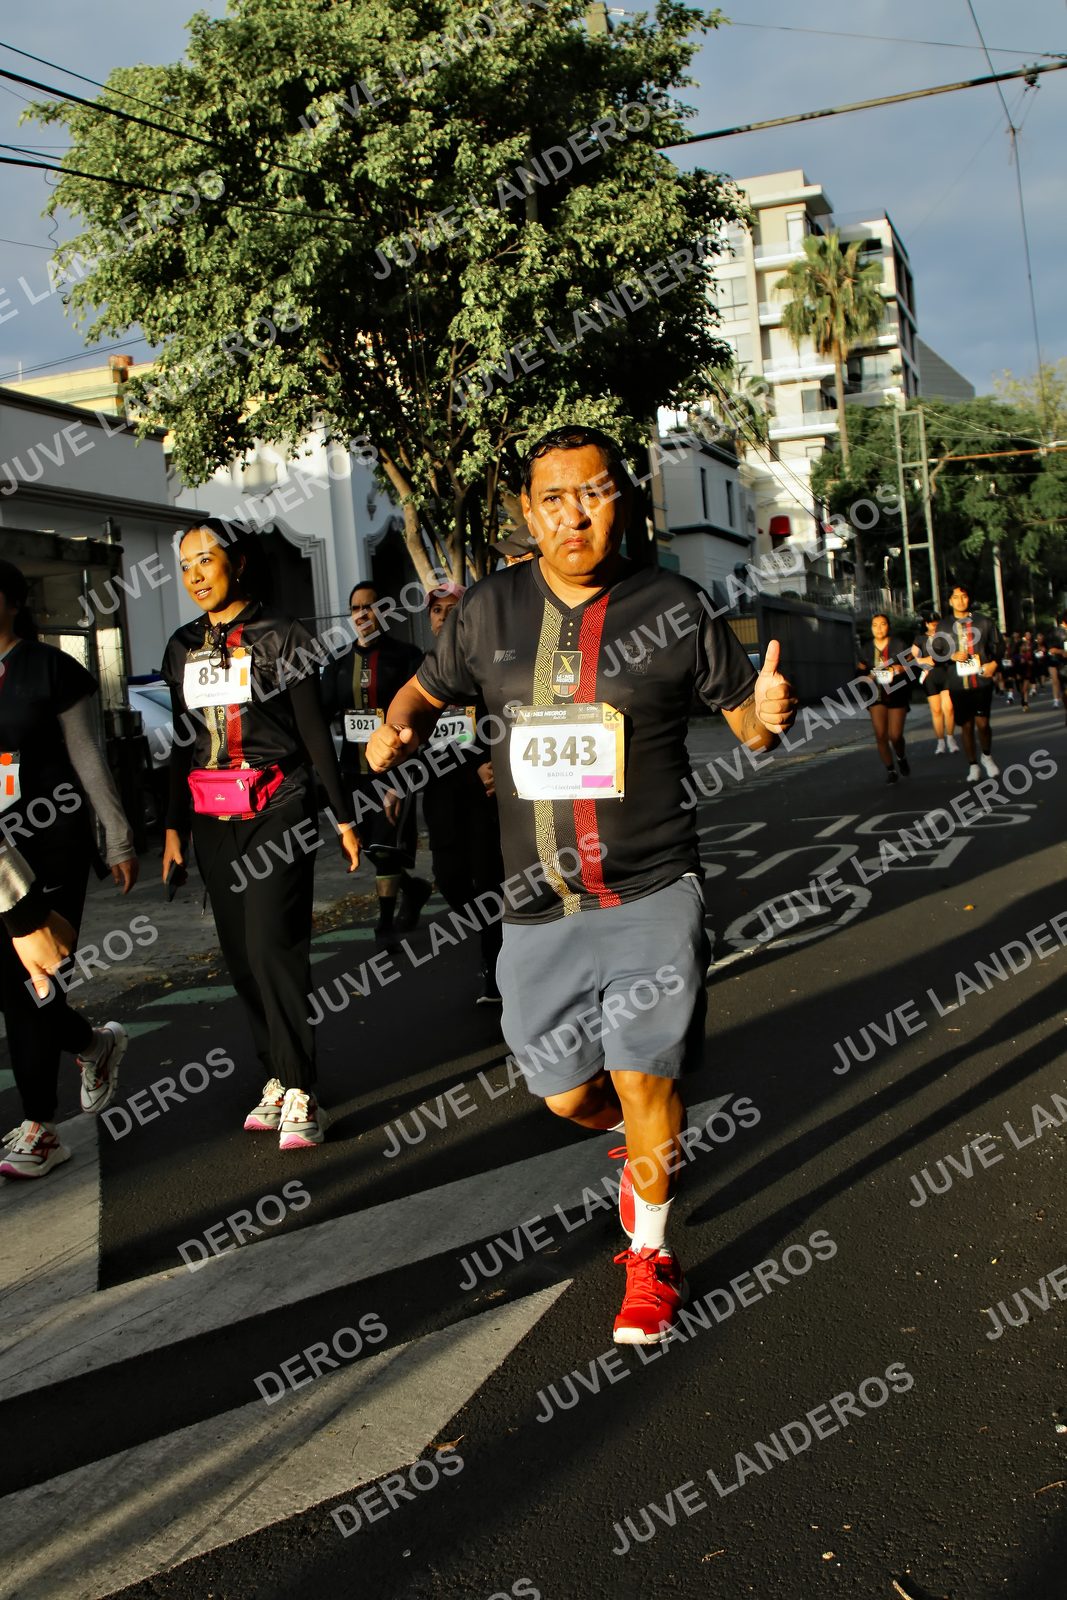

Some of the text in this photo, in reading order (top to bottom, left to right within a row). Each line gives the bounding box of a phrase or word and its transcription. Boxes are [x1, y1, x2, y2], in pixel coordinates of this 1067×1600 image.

[198, 666, 230, 685] 851
[350, 719, 376, 730] 3021
[604, 711, 621, 721] 5K
[434, 721, 466, 738] 2972
[522, 735, 598, 767] 4343
